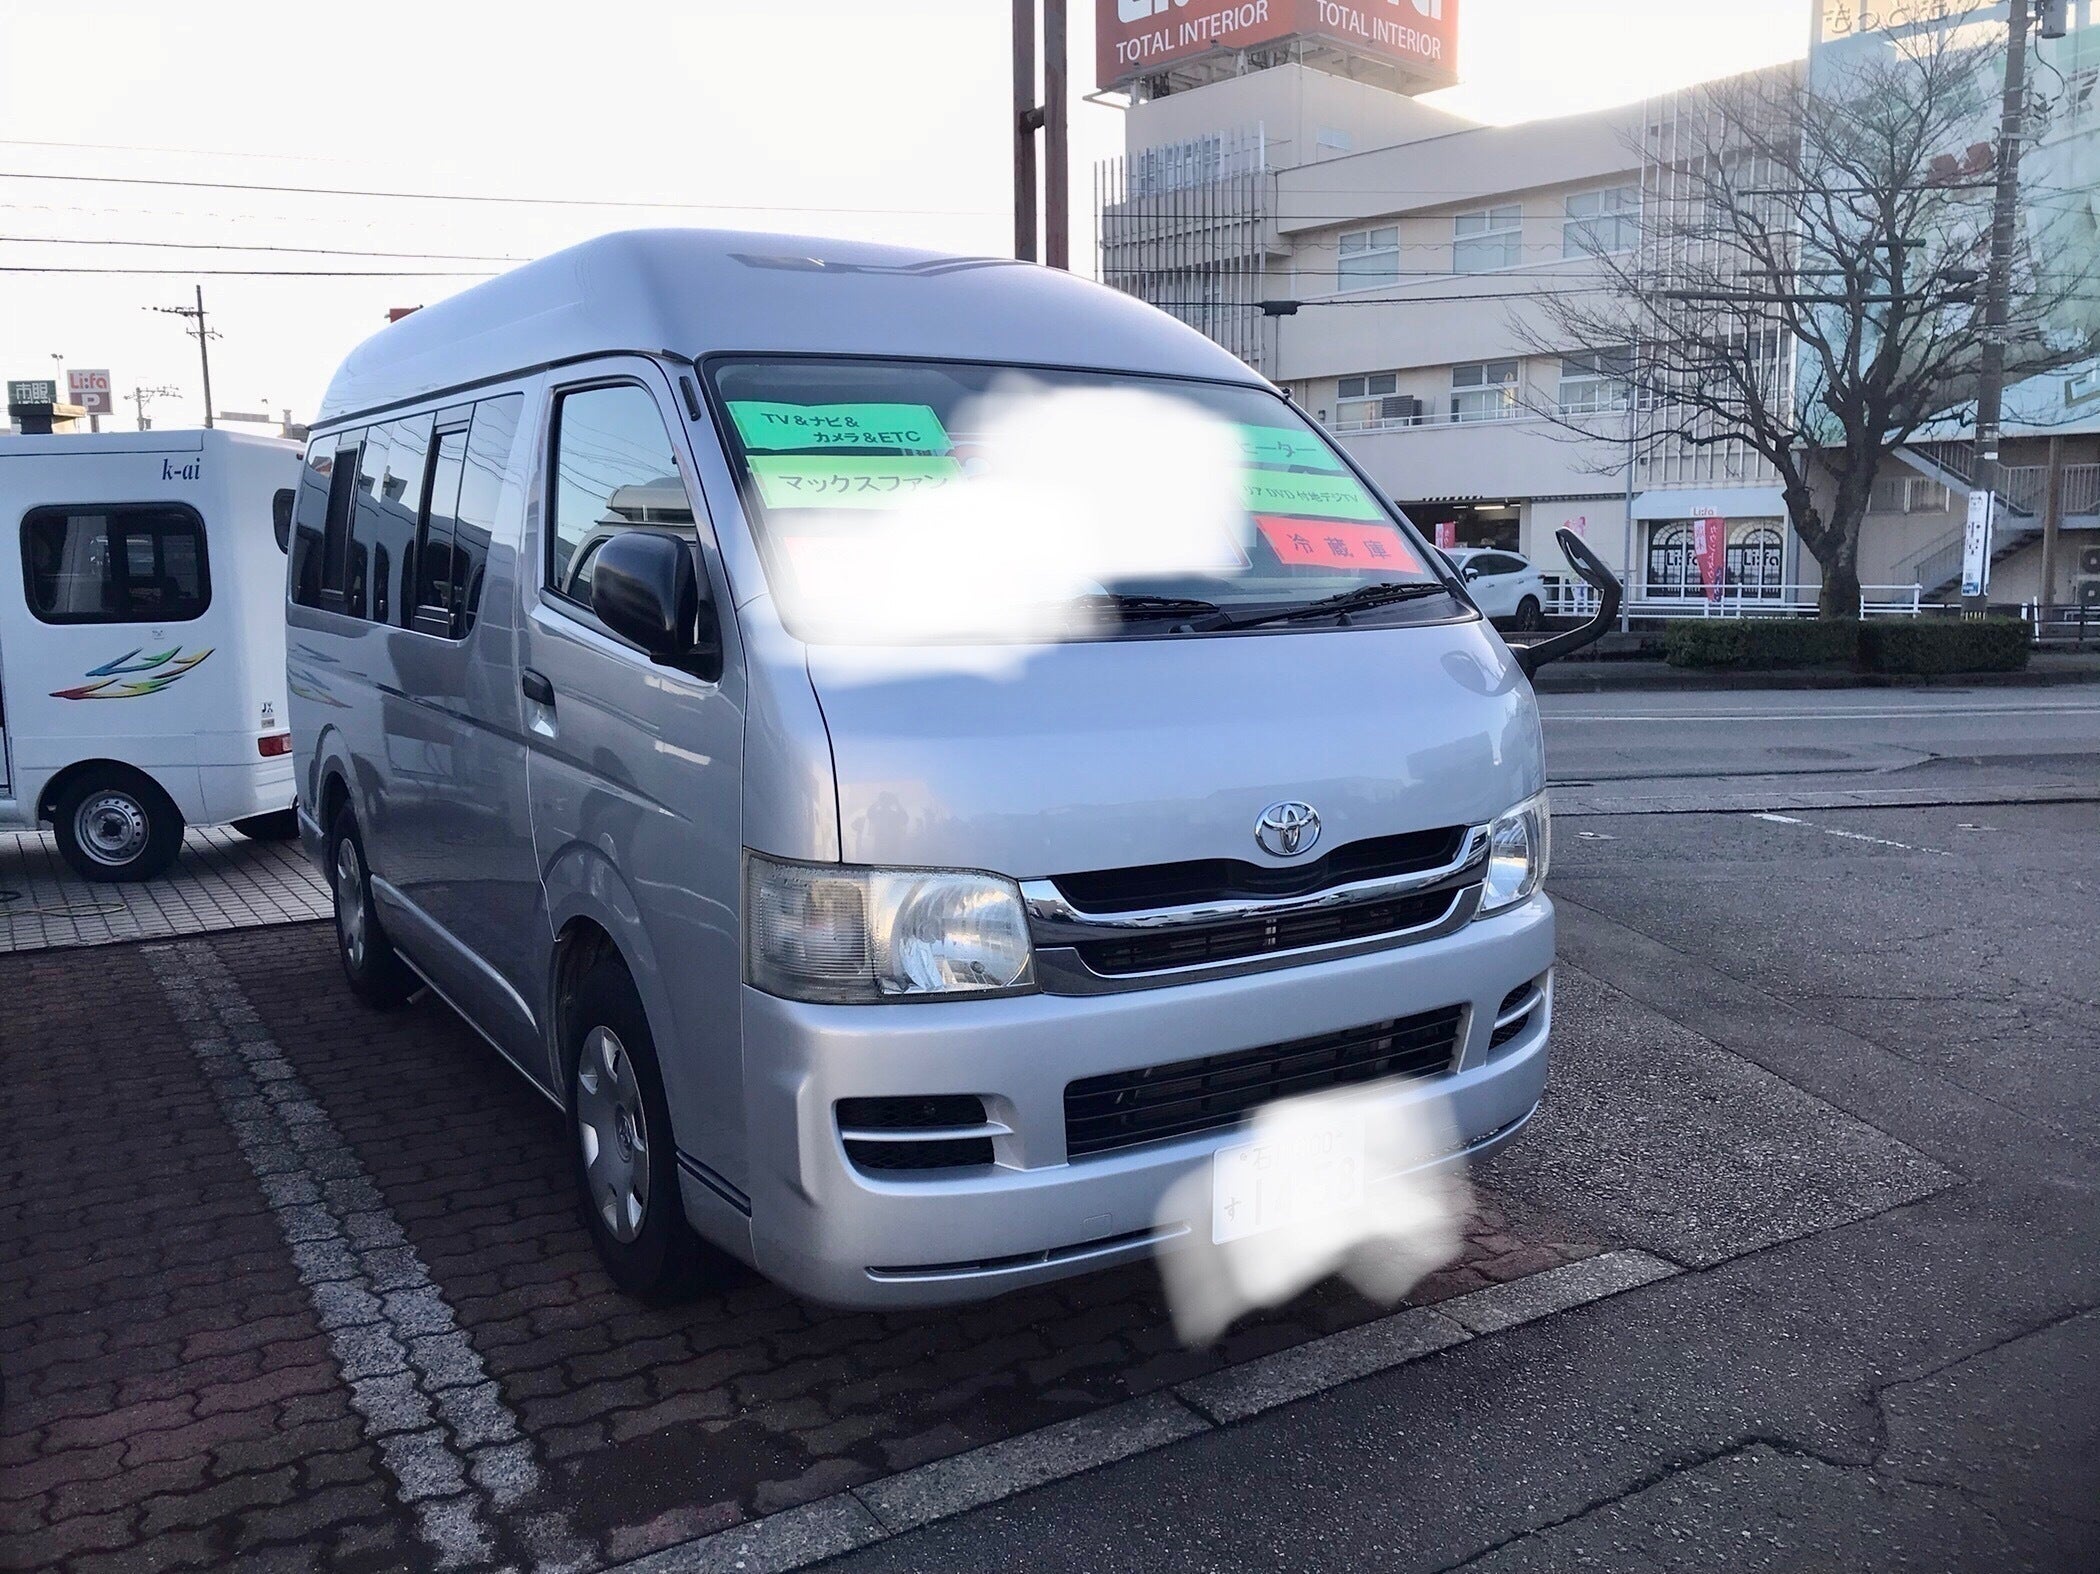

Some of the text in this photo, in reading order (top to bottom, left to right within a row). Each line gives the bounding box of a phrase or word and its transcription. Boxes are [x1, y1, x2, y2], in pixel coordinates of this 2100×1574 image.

[1116, 29, 1174, 64] TOTAL
[1179, 0, 1269, 46] INTERIOR
[1316, 0, 1369, 37] TOTAL
[1373, 17, 1441, 59] INTERIOR
[69, 373, 108, 389] Li:fa
[81, 393, 100, 413] P
[162, 457, 201, 481] k-ai
[778, 474, 949, 494] マックスファン
[1266, 488, 1295, 500] DVD
[1286, 532, 1391, 559] 冷蔵庫
[1744, 551, 1779, 566] Li:fa
